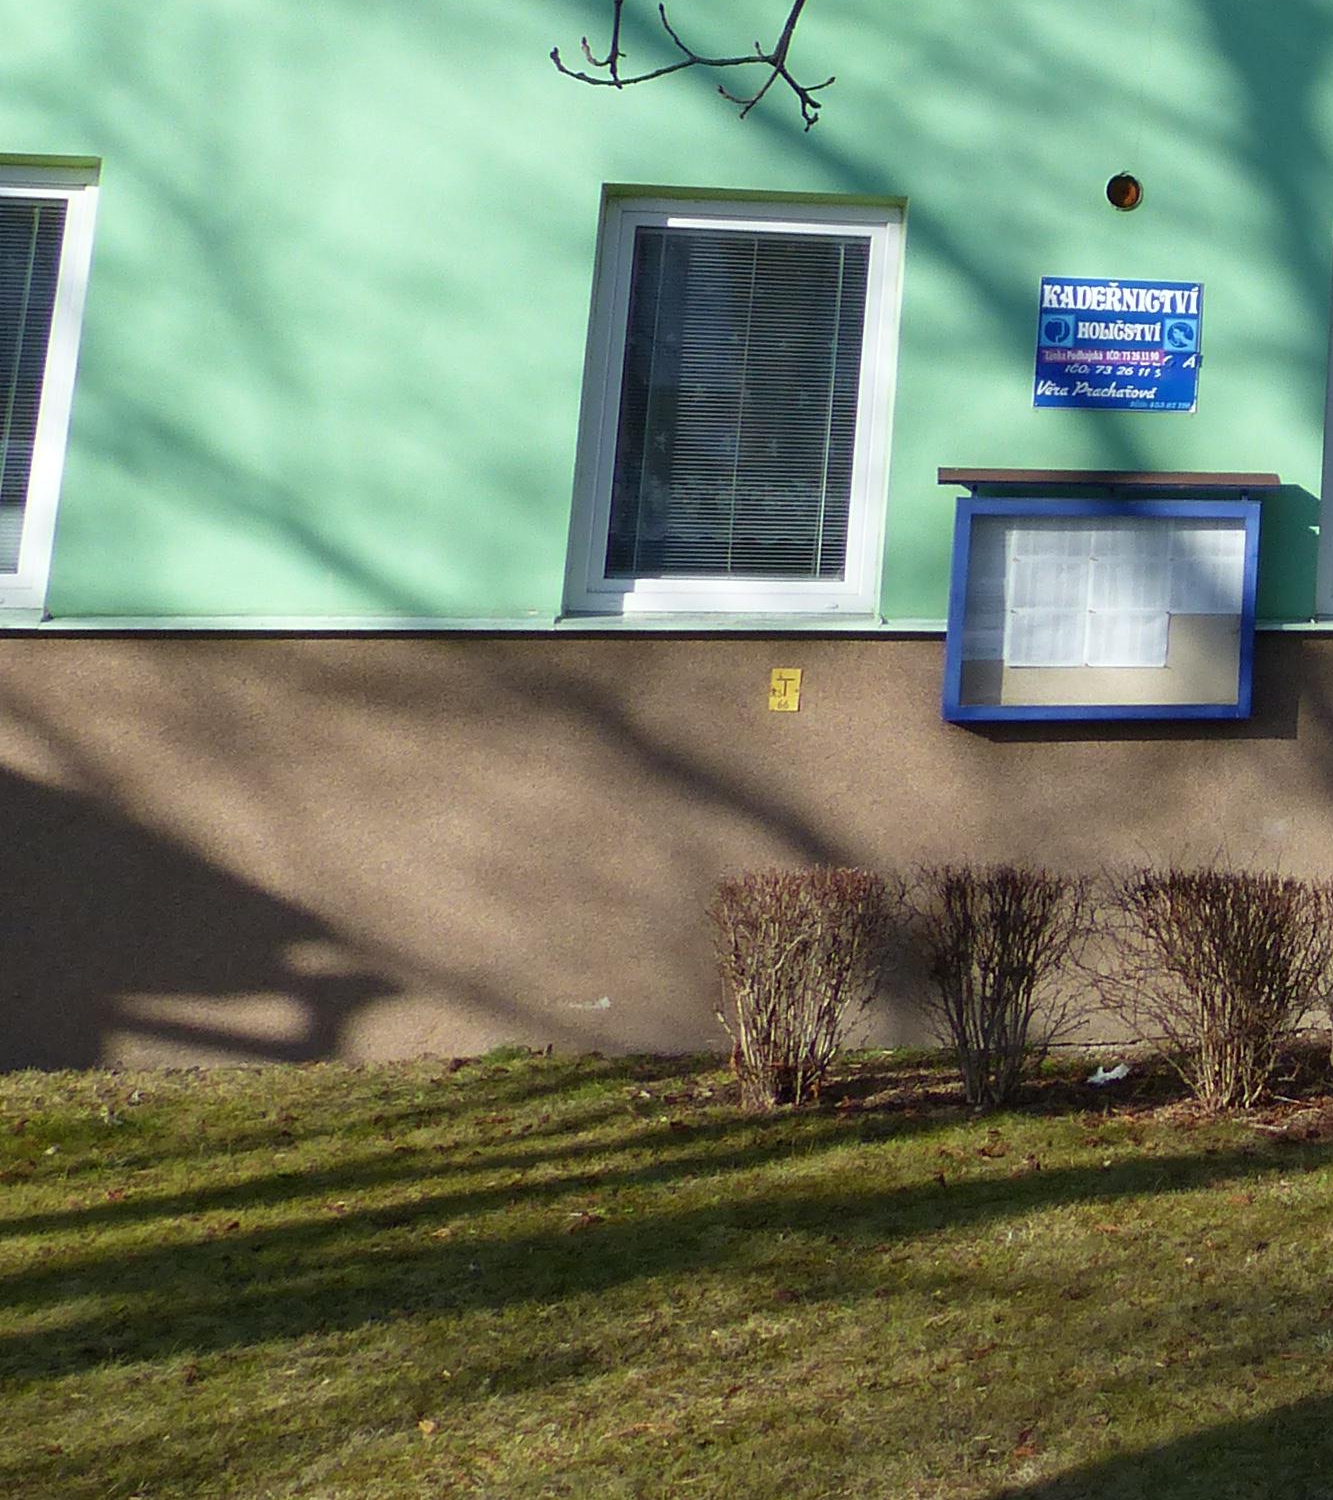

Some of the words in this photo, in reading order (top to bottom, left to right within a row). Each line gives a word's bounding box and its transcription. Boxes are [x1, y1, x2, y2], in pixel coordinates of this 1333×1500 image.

[1041, 282, 1199, 315] KADEŘNICTVÍ
[1076, 320, 1162, 342] HOLIČSTVÍ
[1095, 365, 1113, 375] 73
[1115, 366, 1134, 376] 26
[1036, 379, 1068, 396] Věra
[1071, 381, 1158, 400] Prachařová
